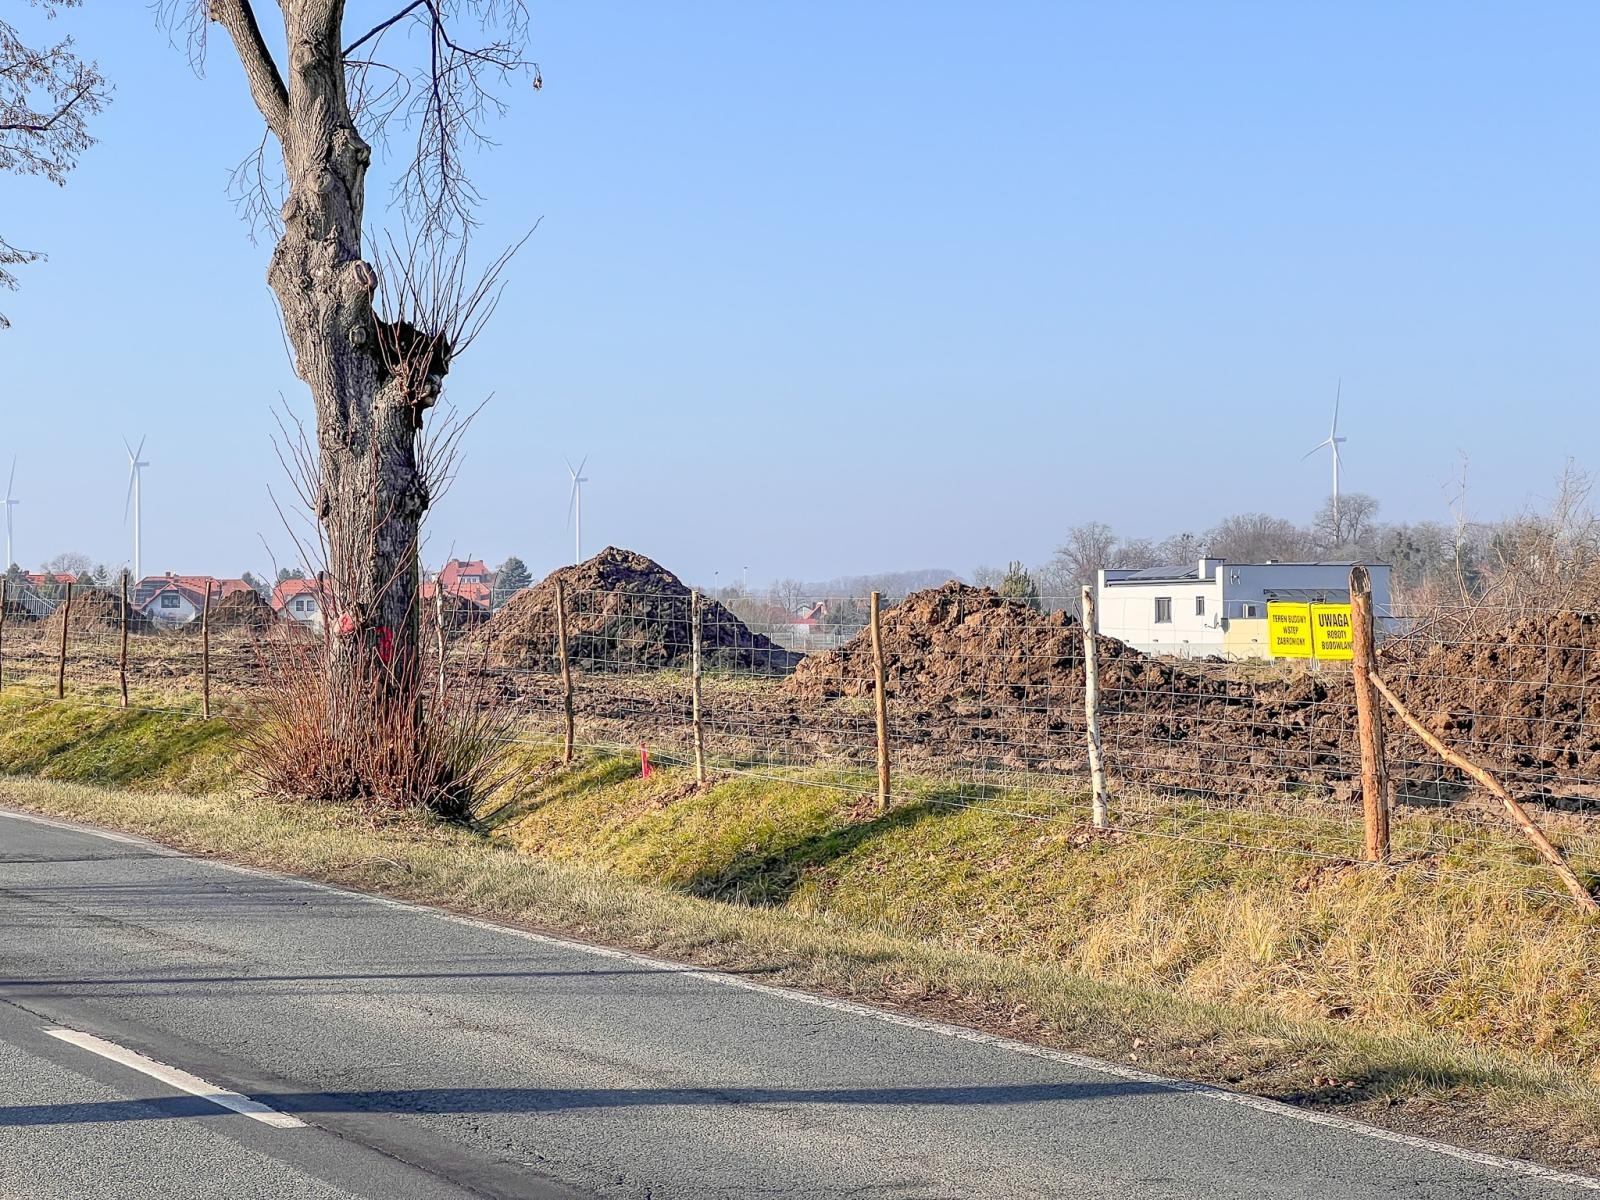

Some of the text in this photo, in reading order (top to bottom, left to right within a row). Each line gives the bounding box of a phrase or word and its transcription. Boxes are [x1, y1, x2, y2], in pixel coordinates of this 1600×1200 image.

[1272, 614, 1287, 622] TEREN
[1318, 613, 1349, 627] UWAGA
[1327, 630, 1347, 639] ROBOTY
[1321, 641, 1352, 650] BUDOWLAN
